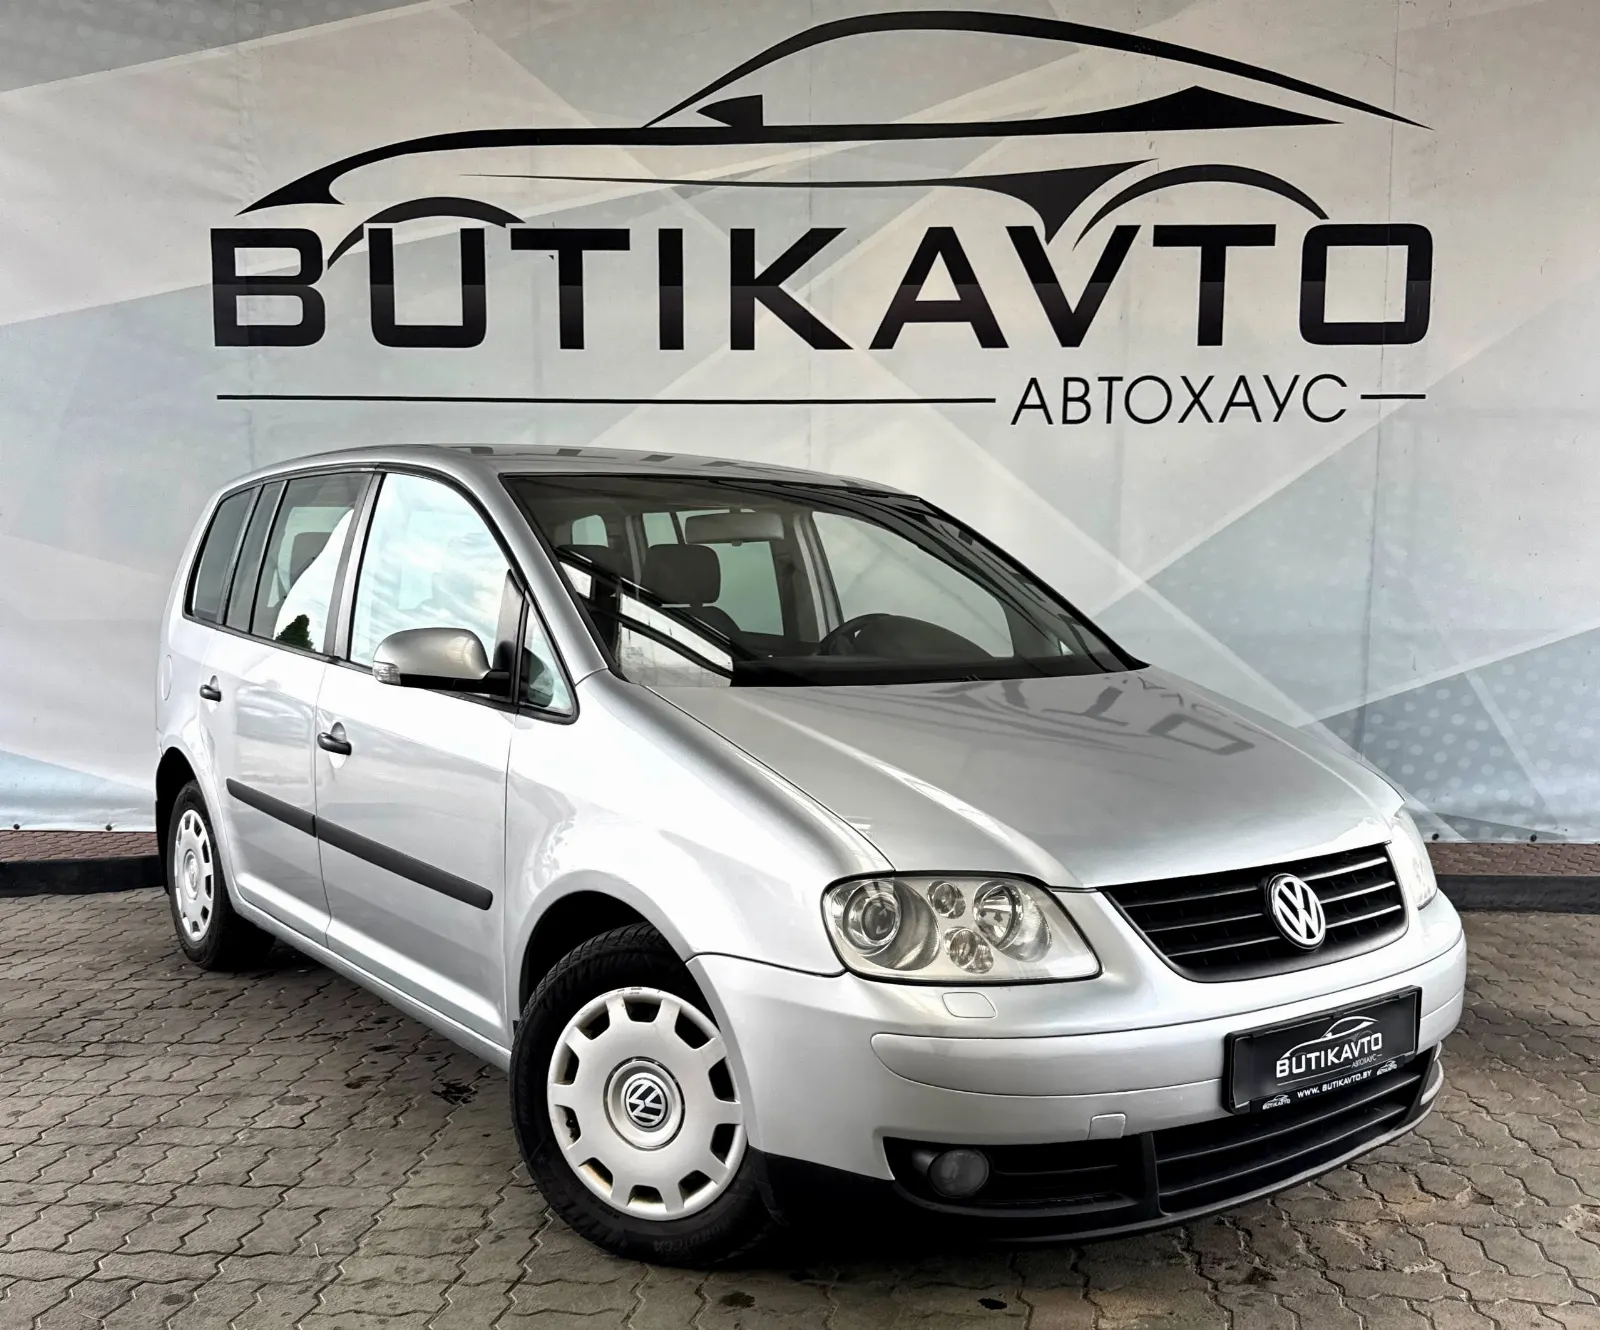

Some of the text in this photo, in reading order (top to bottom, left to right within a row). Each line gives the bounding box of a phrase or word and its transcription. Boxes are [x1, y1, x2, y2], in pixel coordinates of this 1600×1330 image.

[211, 223, 1434, 351] BUTIKAVTO
[1011, 373, 1348, 426] АВТОХАУС
[1276, 1032, 1382, 1078] BUTIKAVTO
